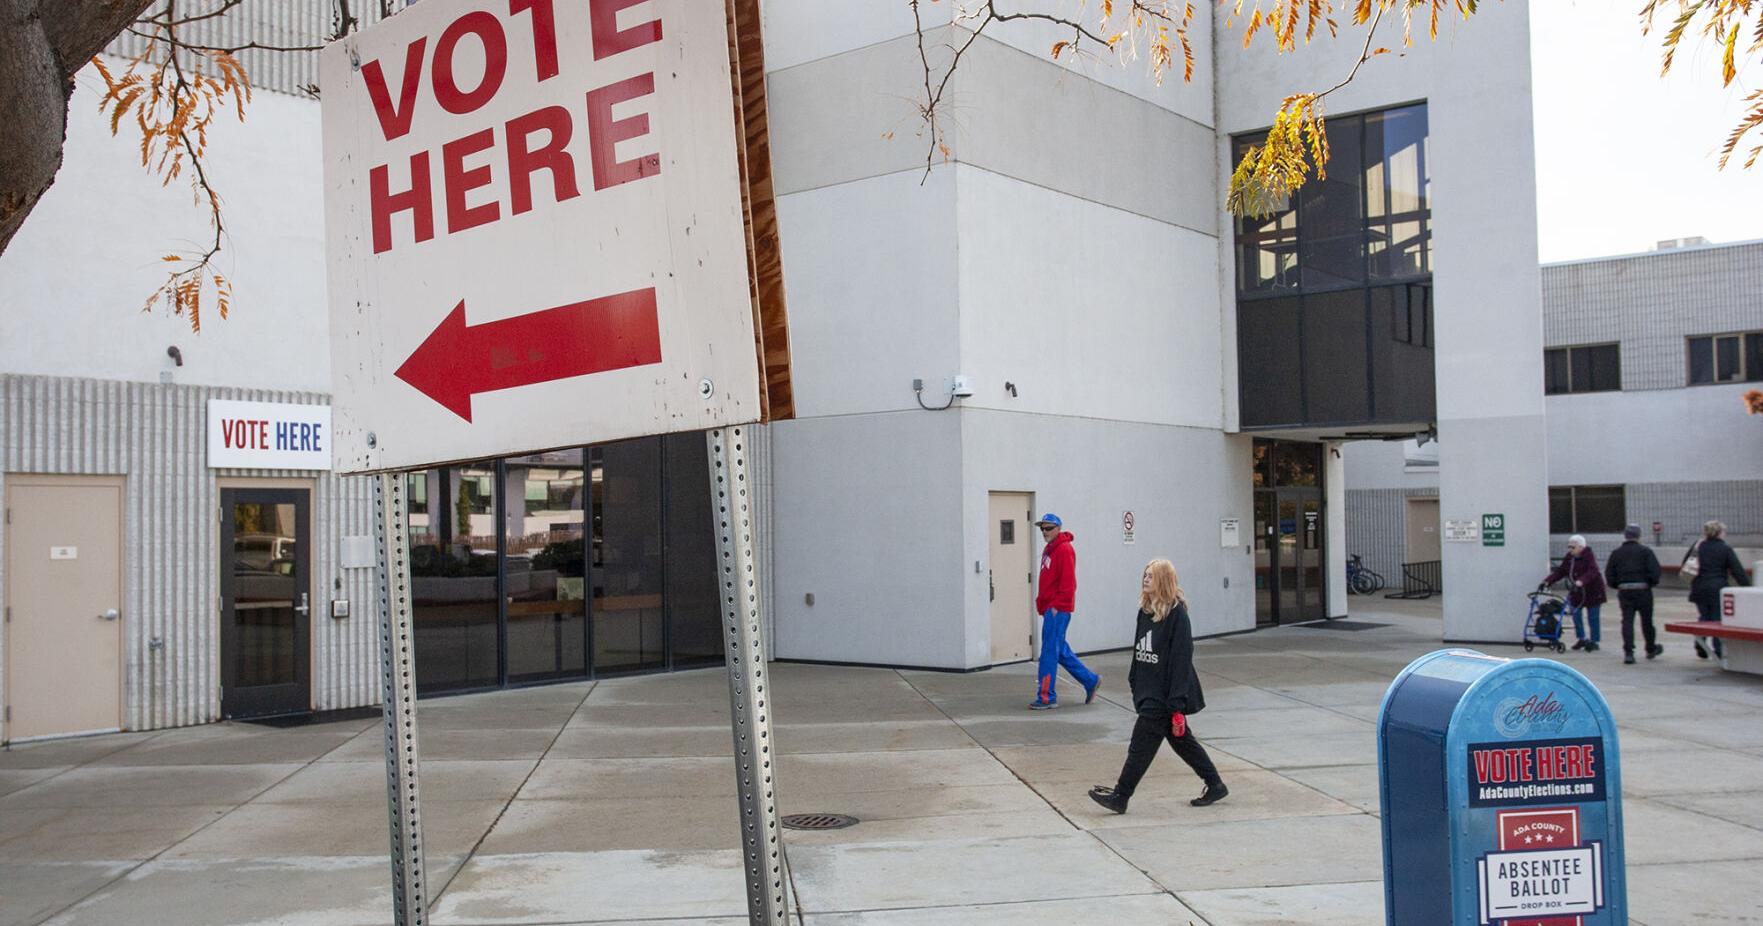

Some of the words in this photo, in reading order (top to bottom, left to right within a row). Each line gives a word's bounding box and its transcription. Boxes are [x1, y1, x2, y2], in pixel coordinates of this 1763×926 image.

[361, 0, 663, 141] VOTE
[369, 71, 661, 255] HERE
[221, 418, 269, 450] VOTE
[276, 421, 322, 452] HERE
[1484, 516, 1502, 528] NO
[1518, 691, 1563, 716] Ada
[1474, 747, 1532, 784] VOTE
[1536, 744, 1595, 781] HERE
[1479, 783, 1594, 800] AdaCountyElections.com
[1513, 825, 1531, 837] ADA
[1531, 822, 1565, 834] COUNTY
[1498, 858, 1582, 879] ABSENTEE
[1510, 878, 1570, 897] BALLOT
[1521, 902, 1543, 910] DROP
